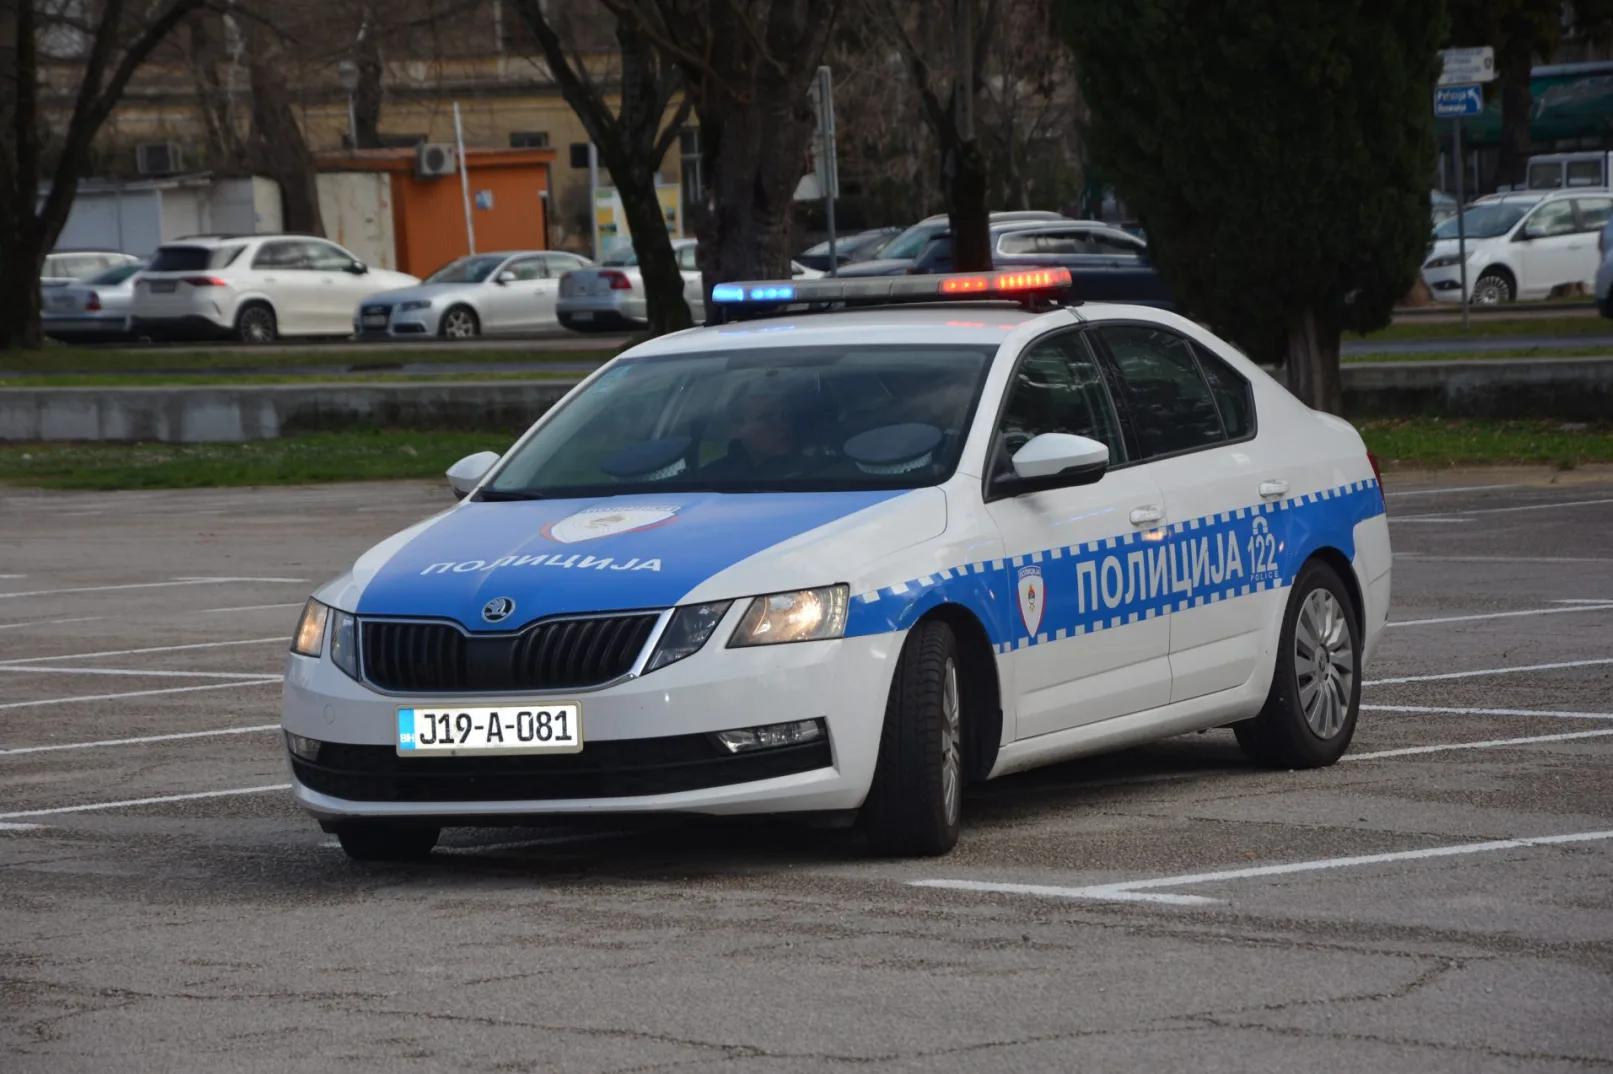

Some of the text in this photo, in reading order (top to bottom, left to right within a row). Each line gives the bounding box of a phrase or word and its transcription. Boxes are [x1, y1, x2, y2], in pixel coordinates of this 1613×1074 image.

[420, 554, 661, 576] ПОЛИЦИЈА
[1248, 533, 1278, 574] 122
[1076, 530, 1244, 615] ПОЛИЦИЈА
[1250, 571, 1280, 582] POLICE
[399, 733, 415, 743] BH
[419, 710, 572, 744] J19-A-081
